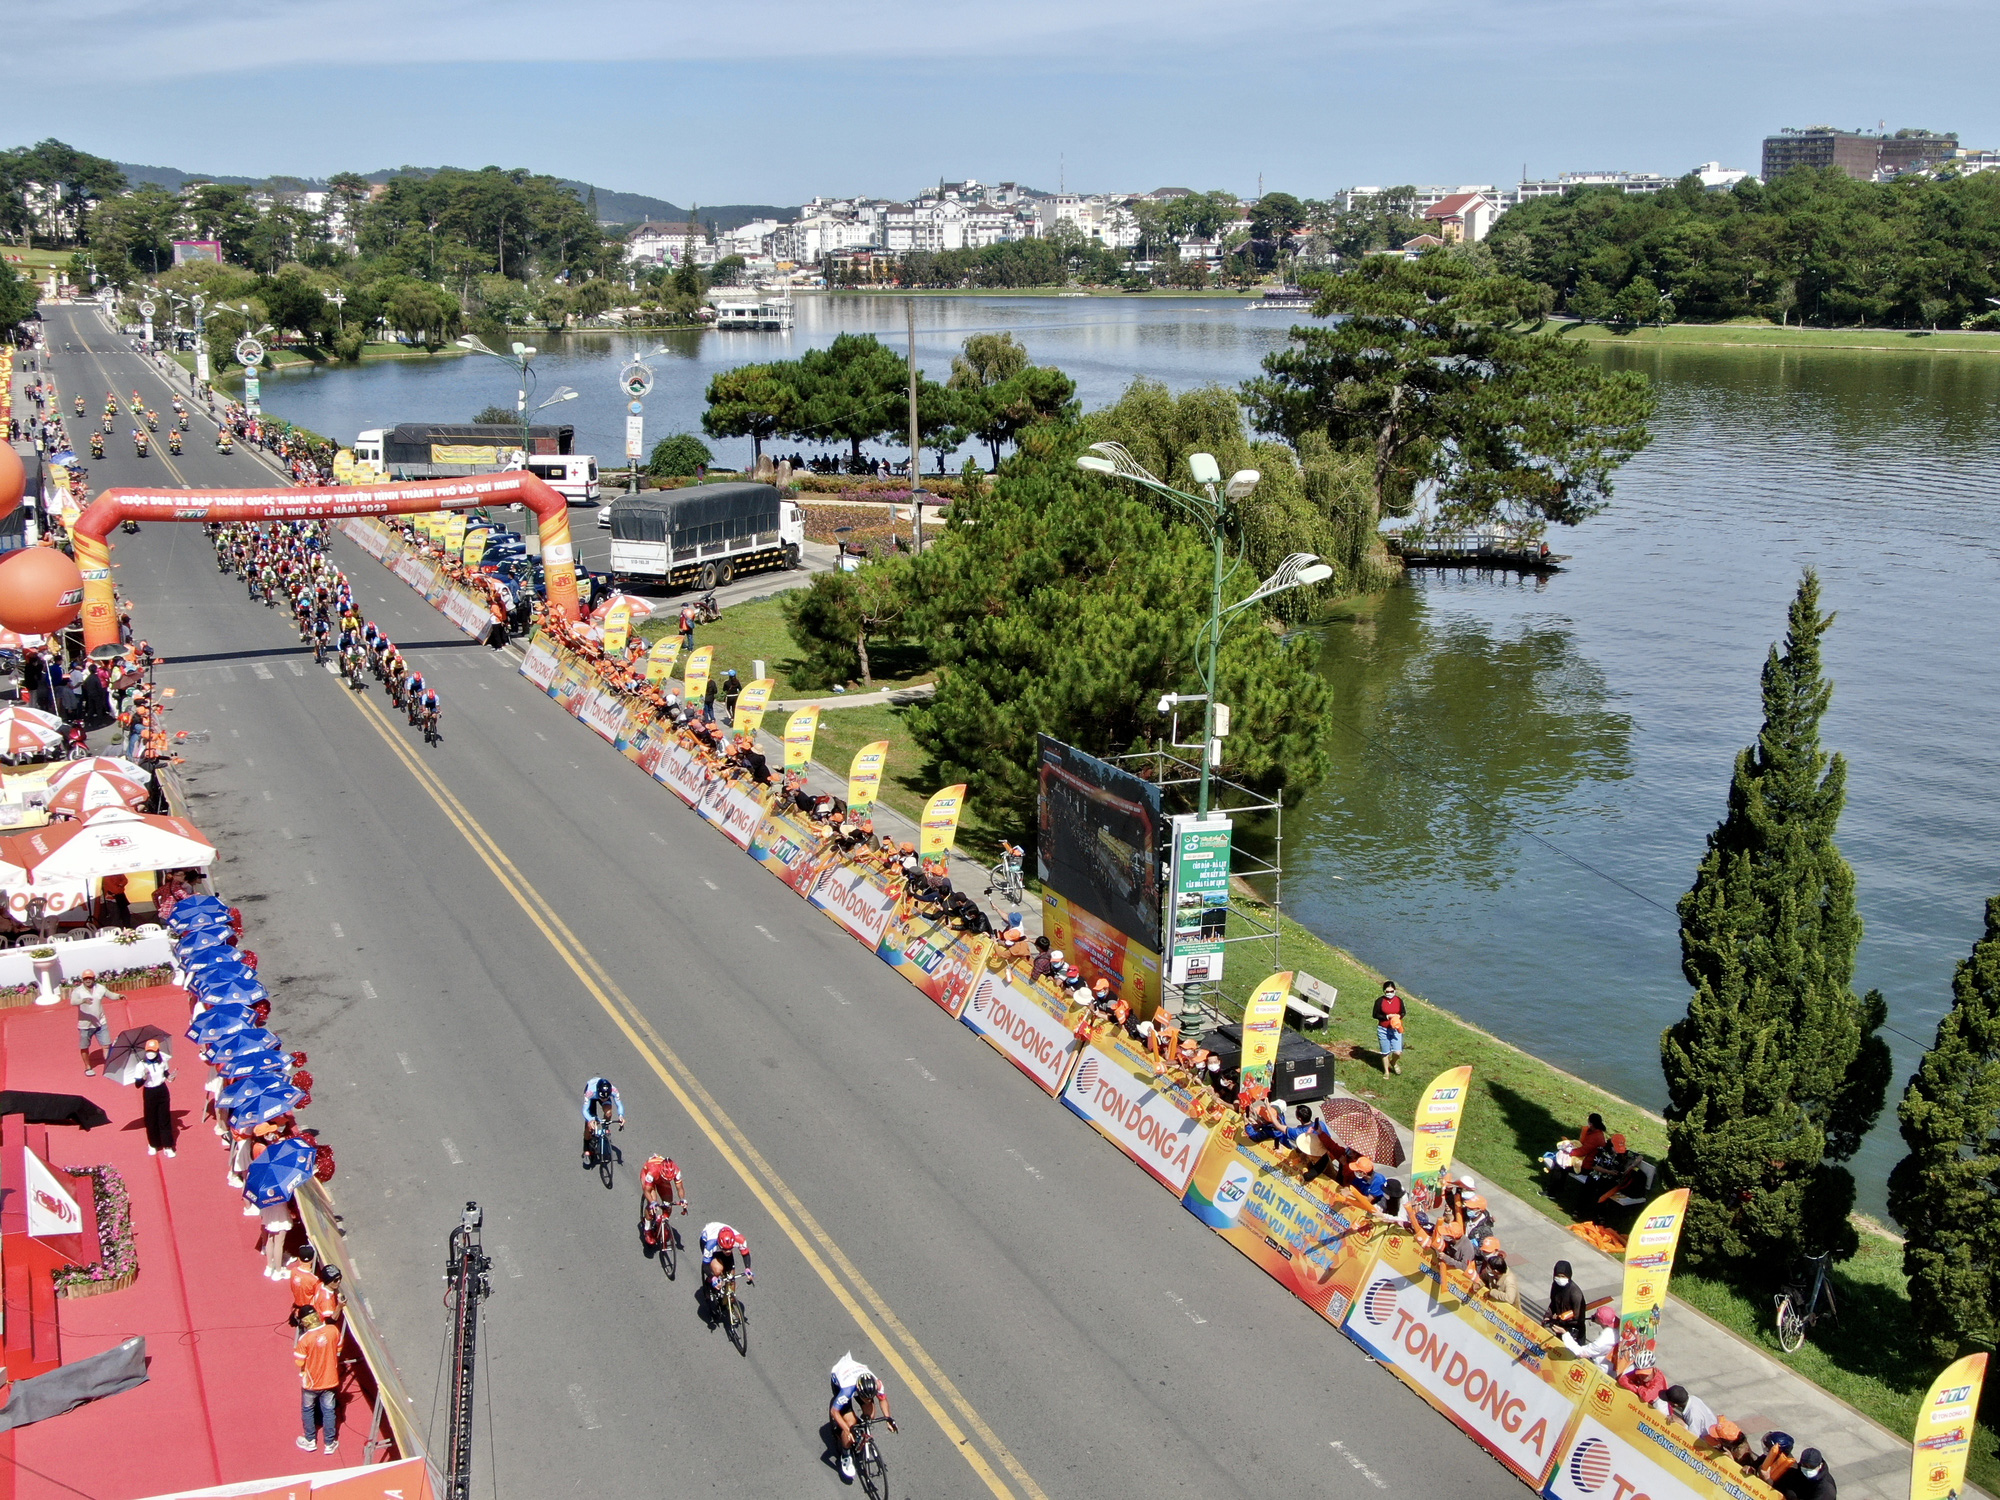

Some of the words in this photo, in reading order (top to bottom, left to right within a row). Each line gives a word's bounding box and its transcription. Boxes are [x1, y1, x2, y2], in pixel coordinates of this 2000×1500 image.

[120, 495, 148, 506] CUỘC
[175, 496, 189, 506] XE
[215, 495, 239, 506] TOÀN
[246, 494, 274, 506] QUỐC
[276, 495, 310, 505] TRANH
[313, 492, 332, 504] CÚP
[401, 487, 434, 499] THÀNH
[436, 484, 457, 496] PHỐ
[459, 483, 474, 495] HỒ
[476, 481, 492, 493] CHÍ
[494, 480, 520, 491] MINH
[174, 509, 208, 518] HTV
[264, 505, 284, 516] LẦN
[286, 505, 306, 515] THỨ
[309, 507, 323, 515] 34
[333, 503, 357, 514] NĂM
[360, 504, 388, 513] 2022
[81, 569, 109, 580] HTV
[827, 878, 851, 907] TON
[846, 893, 877, 928] DONG
[872, 914, 884, 935] A
[1258, 992, 1281, 1002] HTV
[986, 997, 1018, 1039] TON
[1012, 1017, 1053, 1064] DONG
[1049, 1050, 1064, 1075] A
[1432, 1088, 1459, 1100] HTV
[1091, 1078, 1127, 1123] TON
[1124, 1104, 1178, 1159] DONG
[1172, 1144, 1191, 1173] A
[1219, 1180, 1245, 1202] HTV
[1253, 1181, 1276, 1206] GIẢI
[1275, 1196, 1298, 1220] TRÍ
[1295, 1211, 1319, 1238] MỌI
[1268, 1215, 1286, 1236] VUI
[1644, 1215, 1675, 1229] HTV
[1391, 1307, 1449, 1372] TON
[1443, 1351, 1526, 1433] DONG
[1520, 1417, 1548, 1457] A
[1935, 1385, 1971, 1405] HTV
[1638, 1421, 1654, 1436] NON
[1653, 1430, 1674, 1450] SÔNG
[1689, 1457, 1707, 1476] MỘT
